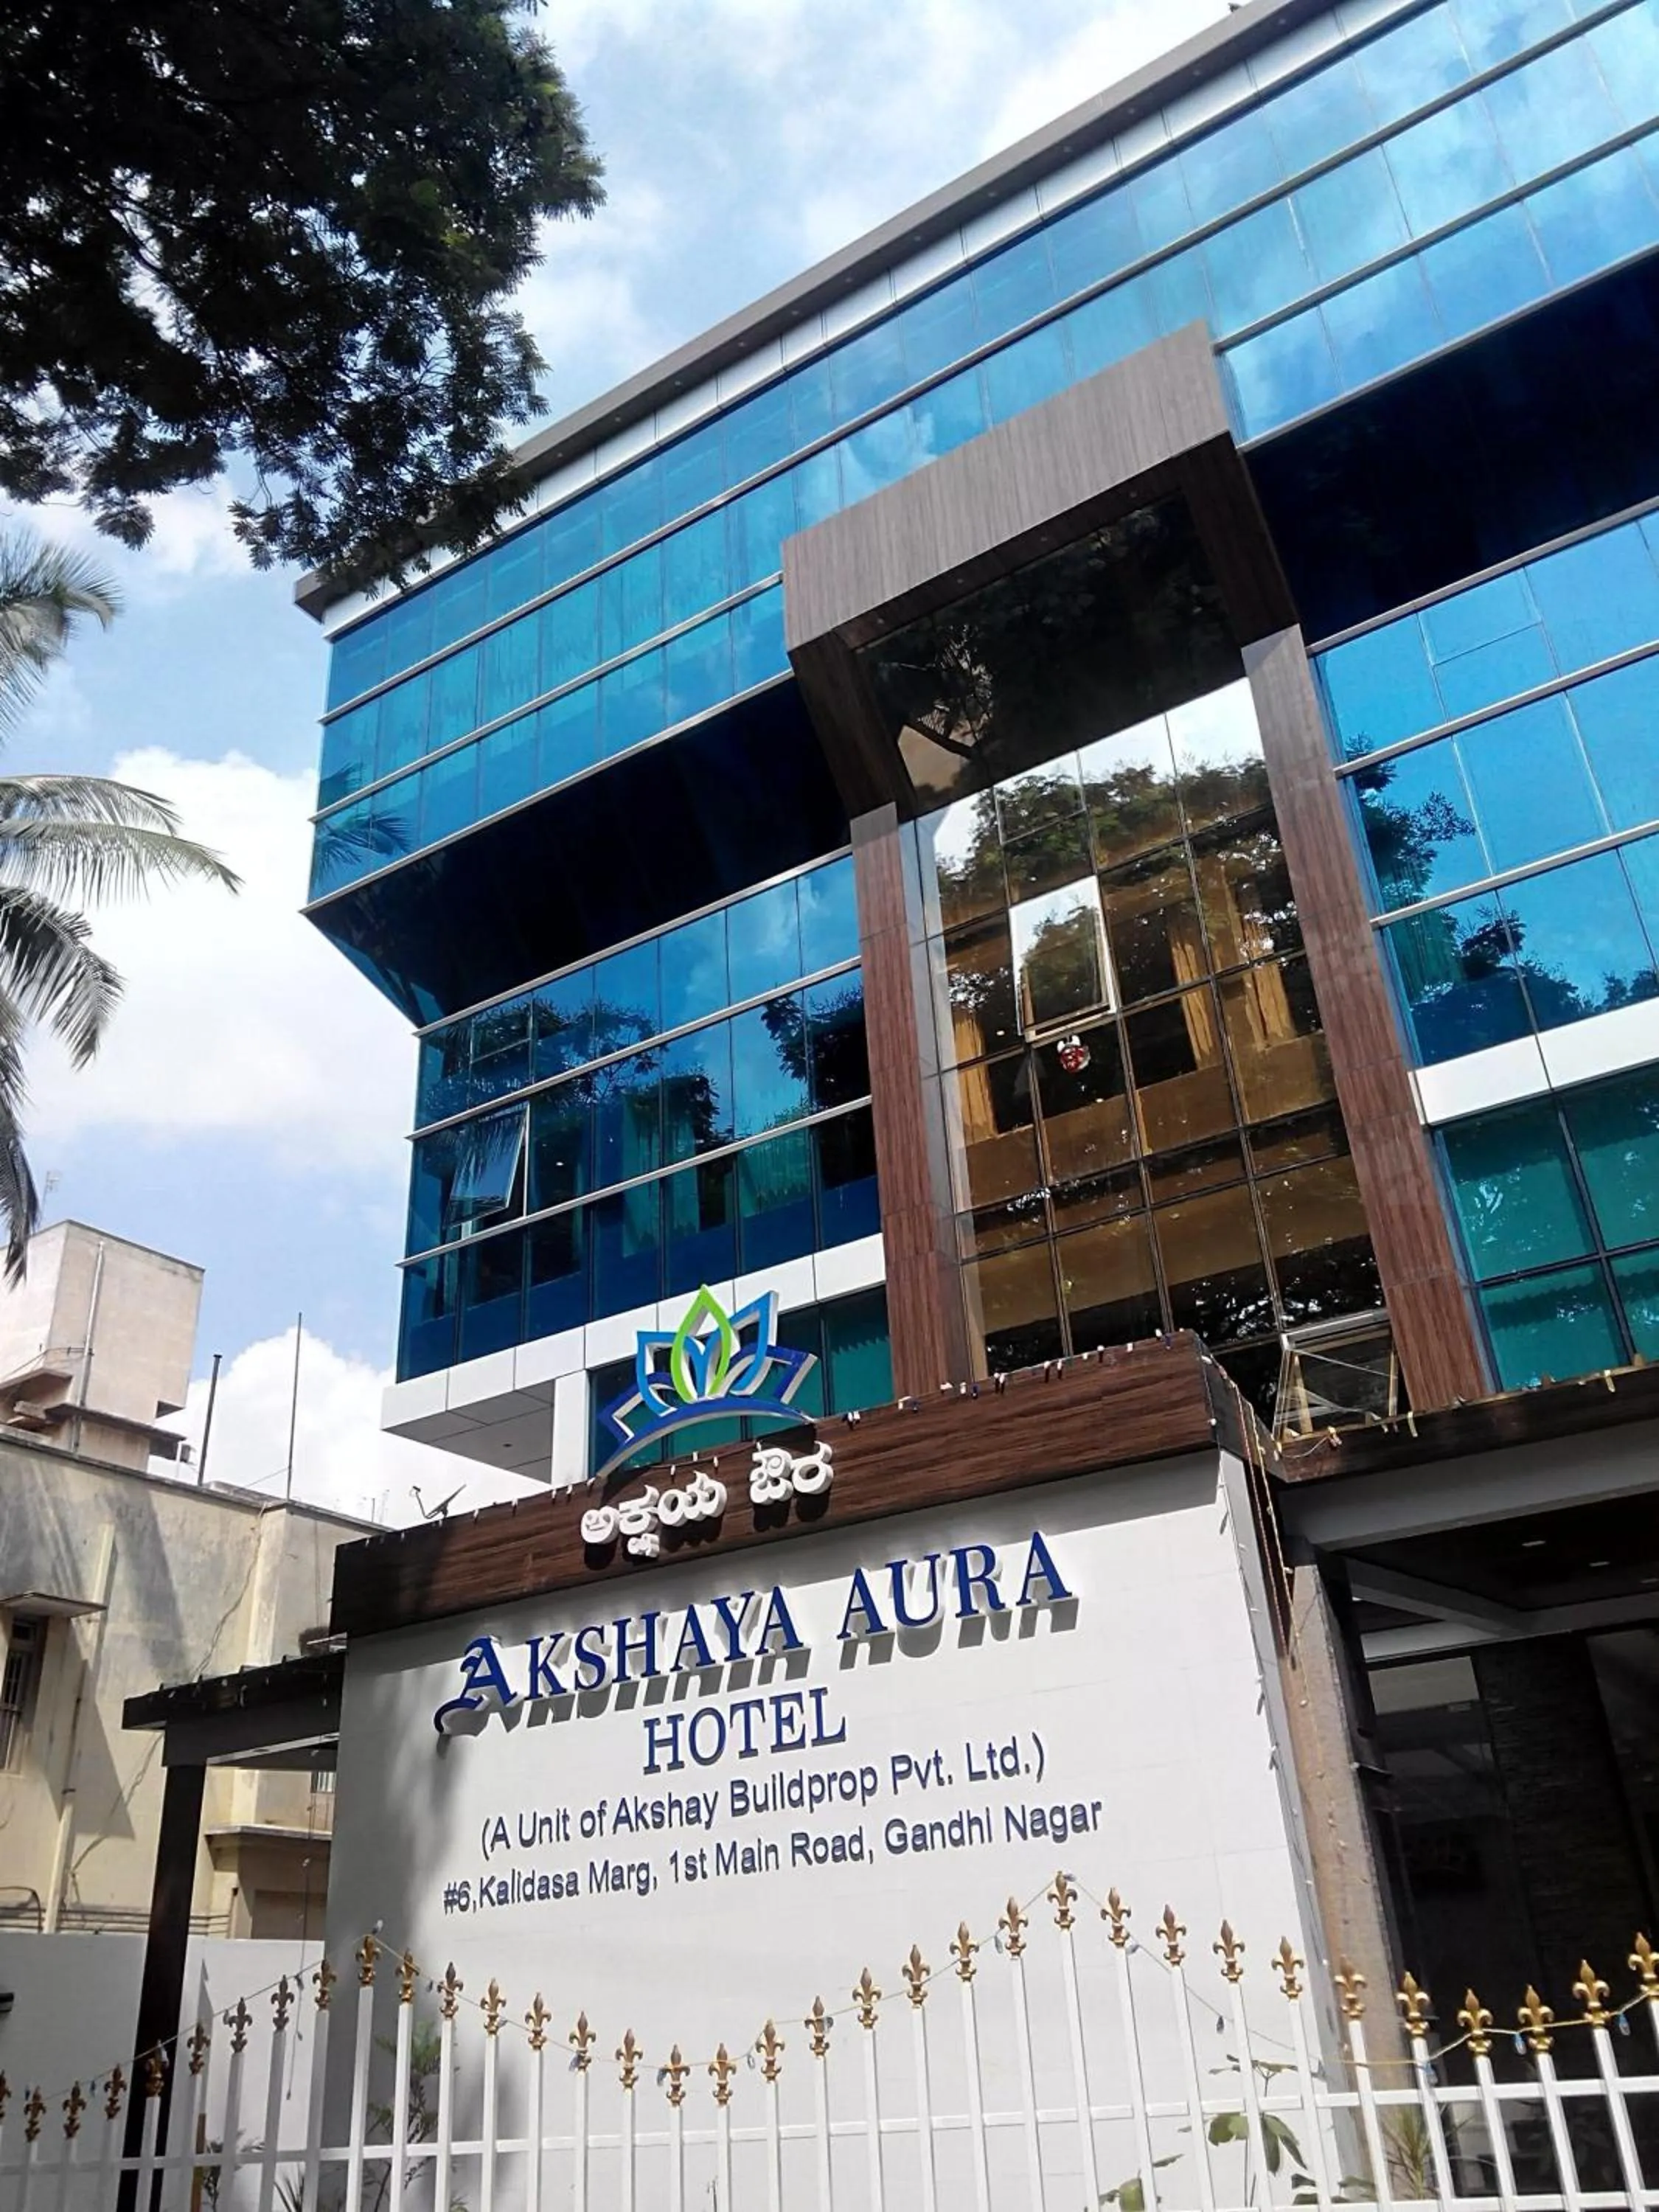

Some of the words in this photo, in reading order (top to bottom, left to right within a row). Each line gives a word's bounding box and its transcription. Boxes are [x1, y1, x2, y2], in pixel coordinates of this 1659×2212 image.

[434, 1586, 804, 1733] AKSHAYA
[837, 1530, 1073, 1641] AURA
[643, 1686, 846, 1775] HOTEL
[481, 1816, 511, 1860] (A
[518, 1808, 571, 1848] Unit
[580, 1800, 608, 1838] of
[613, 1790, 719, 1834] Akshay
[730, 1766, 878, 1818] Buildprop
[891, 1749, 953, 1794] Pvt.
[966, 1732, 1045, 1783] Ltd.)
[588, 1859, 658, 1897] Marg,
[669, 1847, 709, 1883] 1st
[715, 1838, 780, 1876] Main
[790, 1826, 874, 1867] Road,
[884, 1806, 993, 1855] Gandhi
[1004, 1800, 1102, 1843] Nagar
